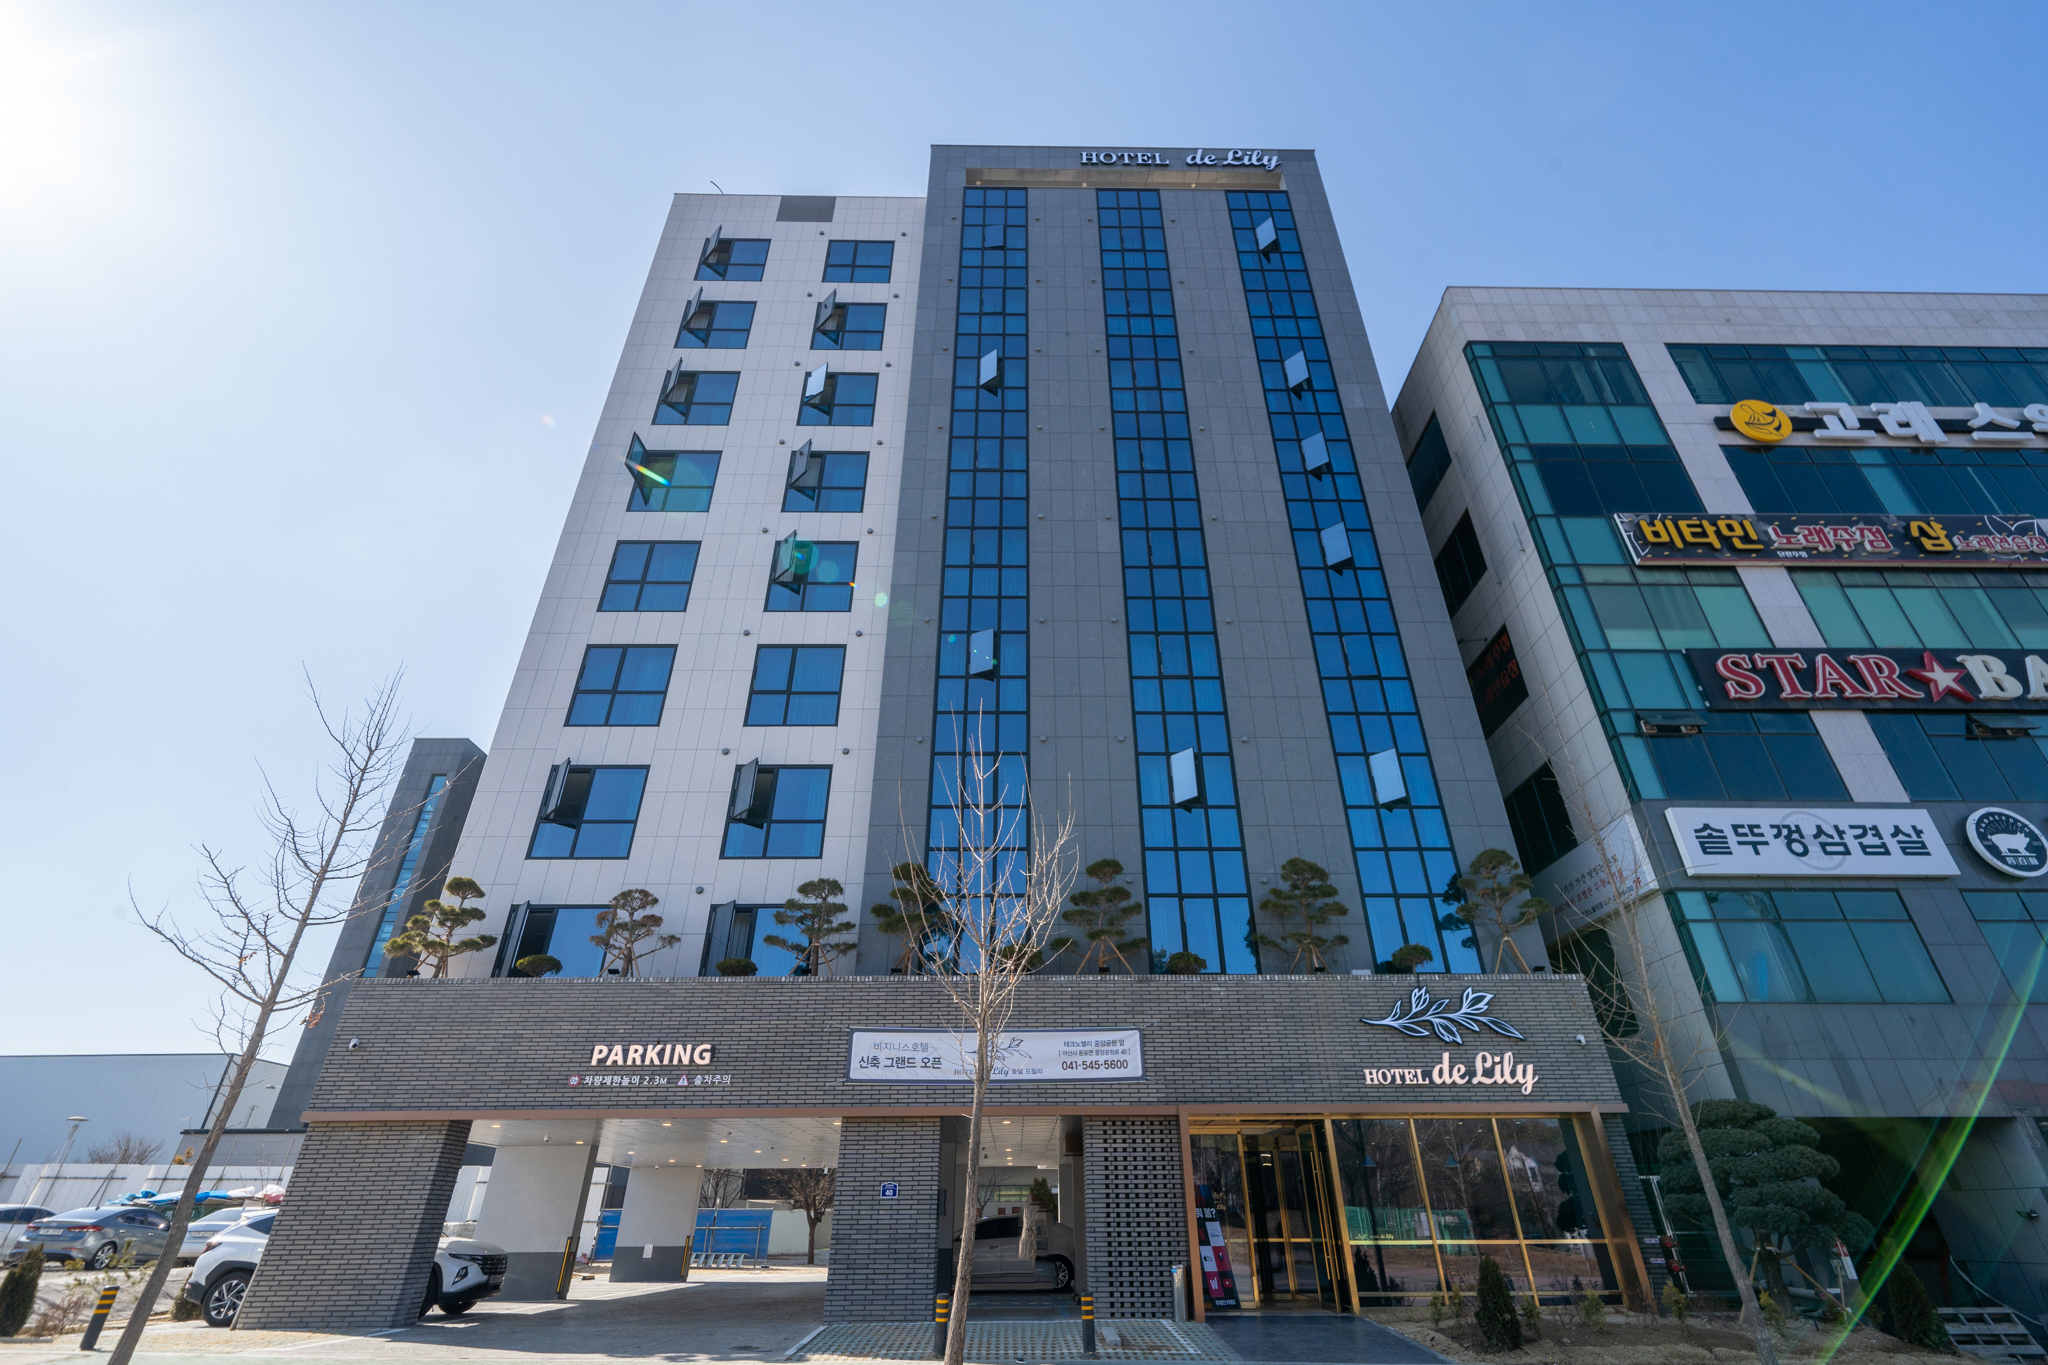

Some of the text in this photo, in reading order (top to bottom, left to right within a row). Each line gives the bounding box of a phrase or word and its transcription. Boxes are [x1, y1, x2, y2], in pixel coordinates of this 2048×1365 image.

[1080, 149, 1281, 171] HOTEL de Lily
[1639, 519, 1893, 552] 비타민 노래주점
[1910, 521, 2048, 553] 샵 노래연습장
[1716, 653, 1924, 700] STAR
[1693, 823, 1932, 857] 솥뚜껑삼겹살
[873, 1042, 929, 1052] 비지니스호텔
[1063, 1039, 1125, 1048] 테크노밸리 중앙공원 앞
[591, 1044, 713, 1066] PARKING
[858, 1056, 942, 1069] 신축 그랜드 오픈
[992, 1061, 1010, 1077] Lily
[1061, 1059, 1129, 1071] 041-545-5600
[1363, 1051, 1539, 1095] HOTEL de Lily
[584, 1075, 640, 1086] 차량제한높이
[643, 1076, 667, 1085] 2.3M
[693, 1075, 731, 1086] 출차주의
